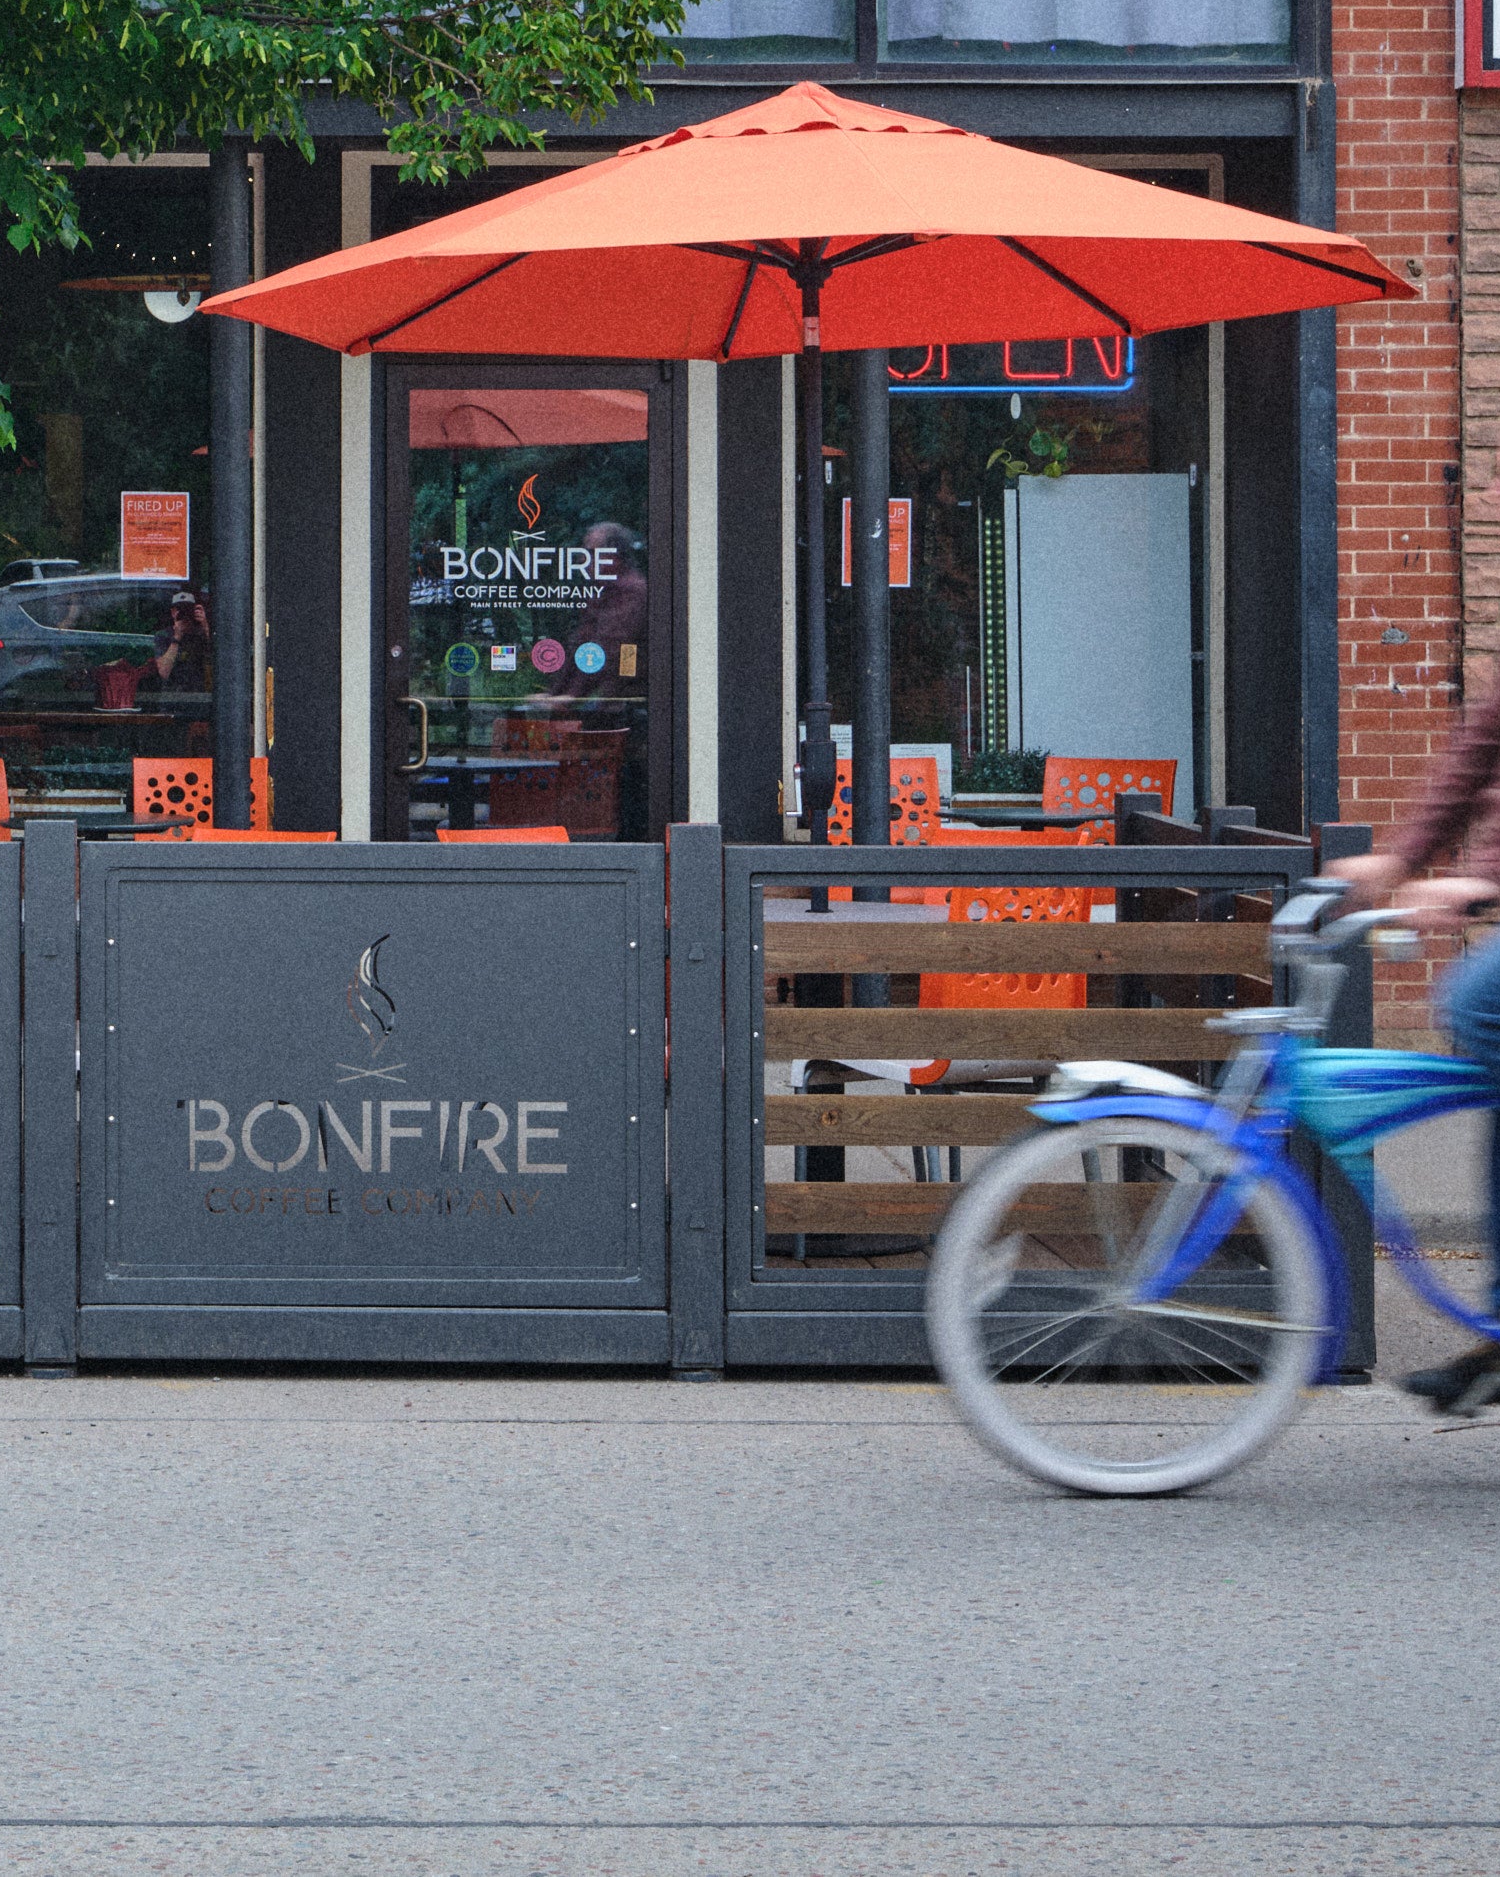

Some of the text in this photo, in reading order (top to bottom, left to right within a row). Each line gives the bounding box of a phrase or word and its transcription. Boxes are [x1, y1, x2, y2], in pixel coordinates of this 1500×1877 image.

[126, 500, 184, 512] FIRED UP
[440, 546, 618, 581] BONFIRE
[454, 585, 605, 599] COFFEE COMPANY
[176, 1099, 568, 1174] BONFIRE
[204, 1187, 544, 1215] COFFEE COMPANY
